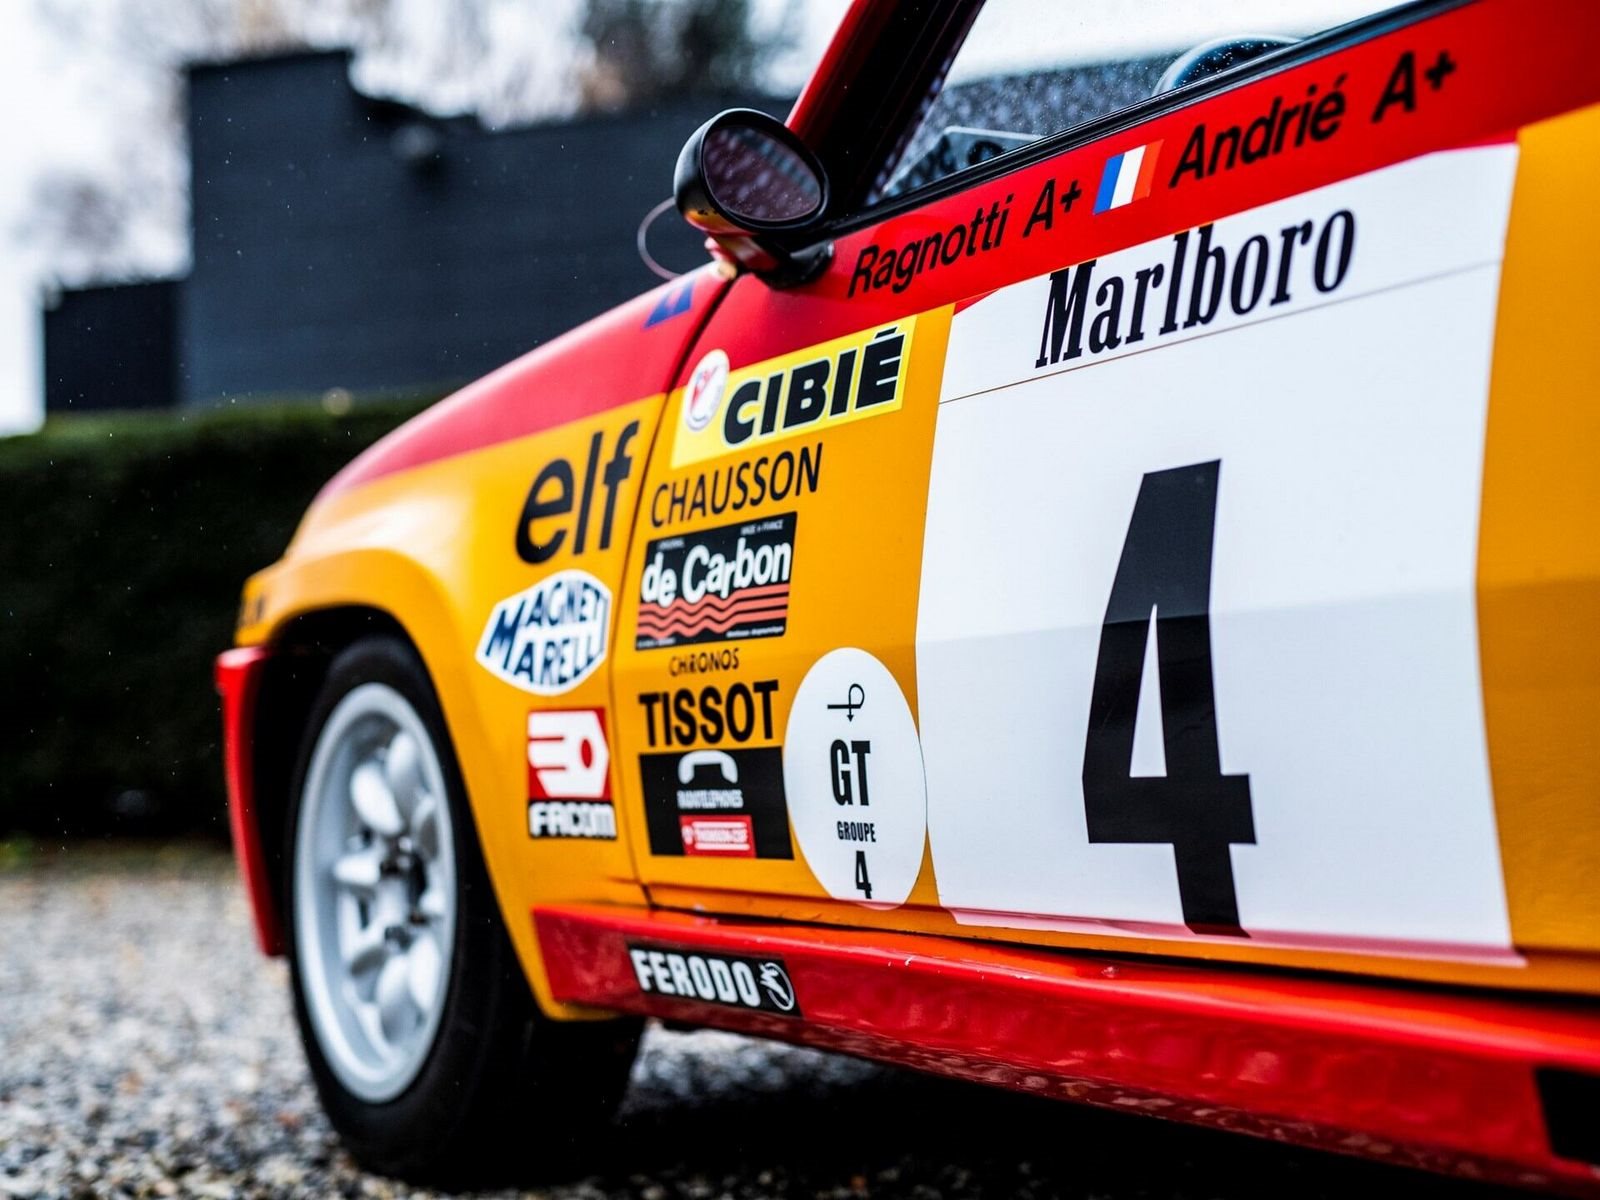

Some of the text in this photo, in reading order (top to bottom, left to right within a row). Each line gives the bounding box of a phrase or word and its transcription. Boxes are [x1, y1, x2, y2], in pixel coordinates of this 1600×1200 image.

[847, 51, 1457, 299] Ragnotti A+ Andrié A+
[1035, 208, 1357, 369] Marlboro
[724, 326, 905, 445] CIBIÉ
[516, 420, 639, 565] elf
[651, 442, 823, 528] CHAUSSON
[641, 537, 792, 609] de Carbon
[669, 648, 739, 676] CHRONOS
[639, 679, 779, 747] TISSOT
[1082, 459, 1257, 938] 4
[830, 739, 871, 806] GT
[529, 802, 616, 837] FACOM
[837, 820, 876, 842] GROUPE
[855, 850, 872, 899] 4
[630, 949, 761, 1007] FERODO
